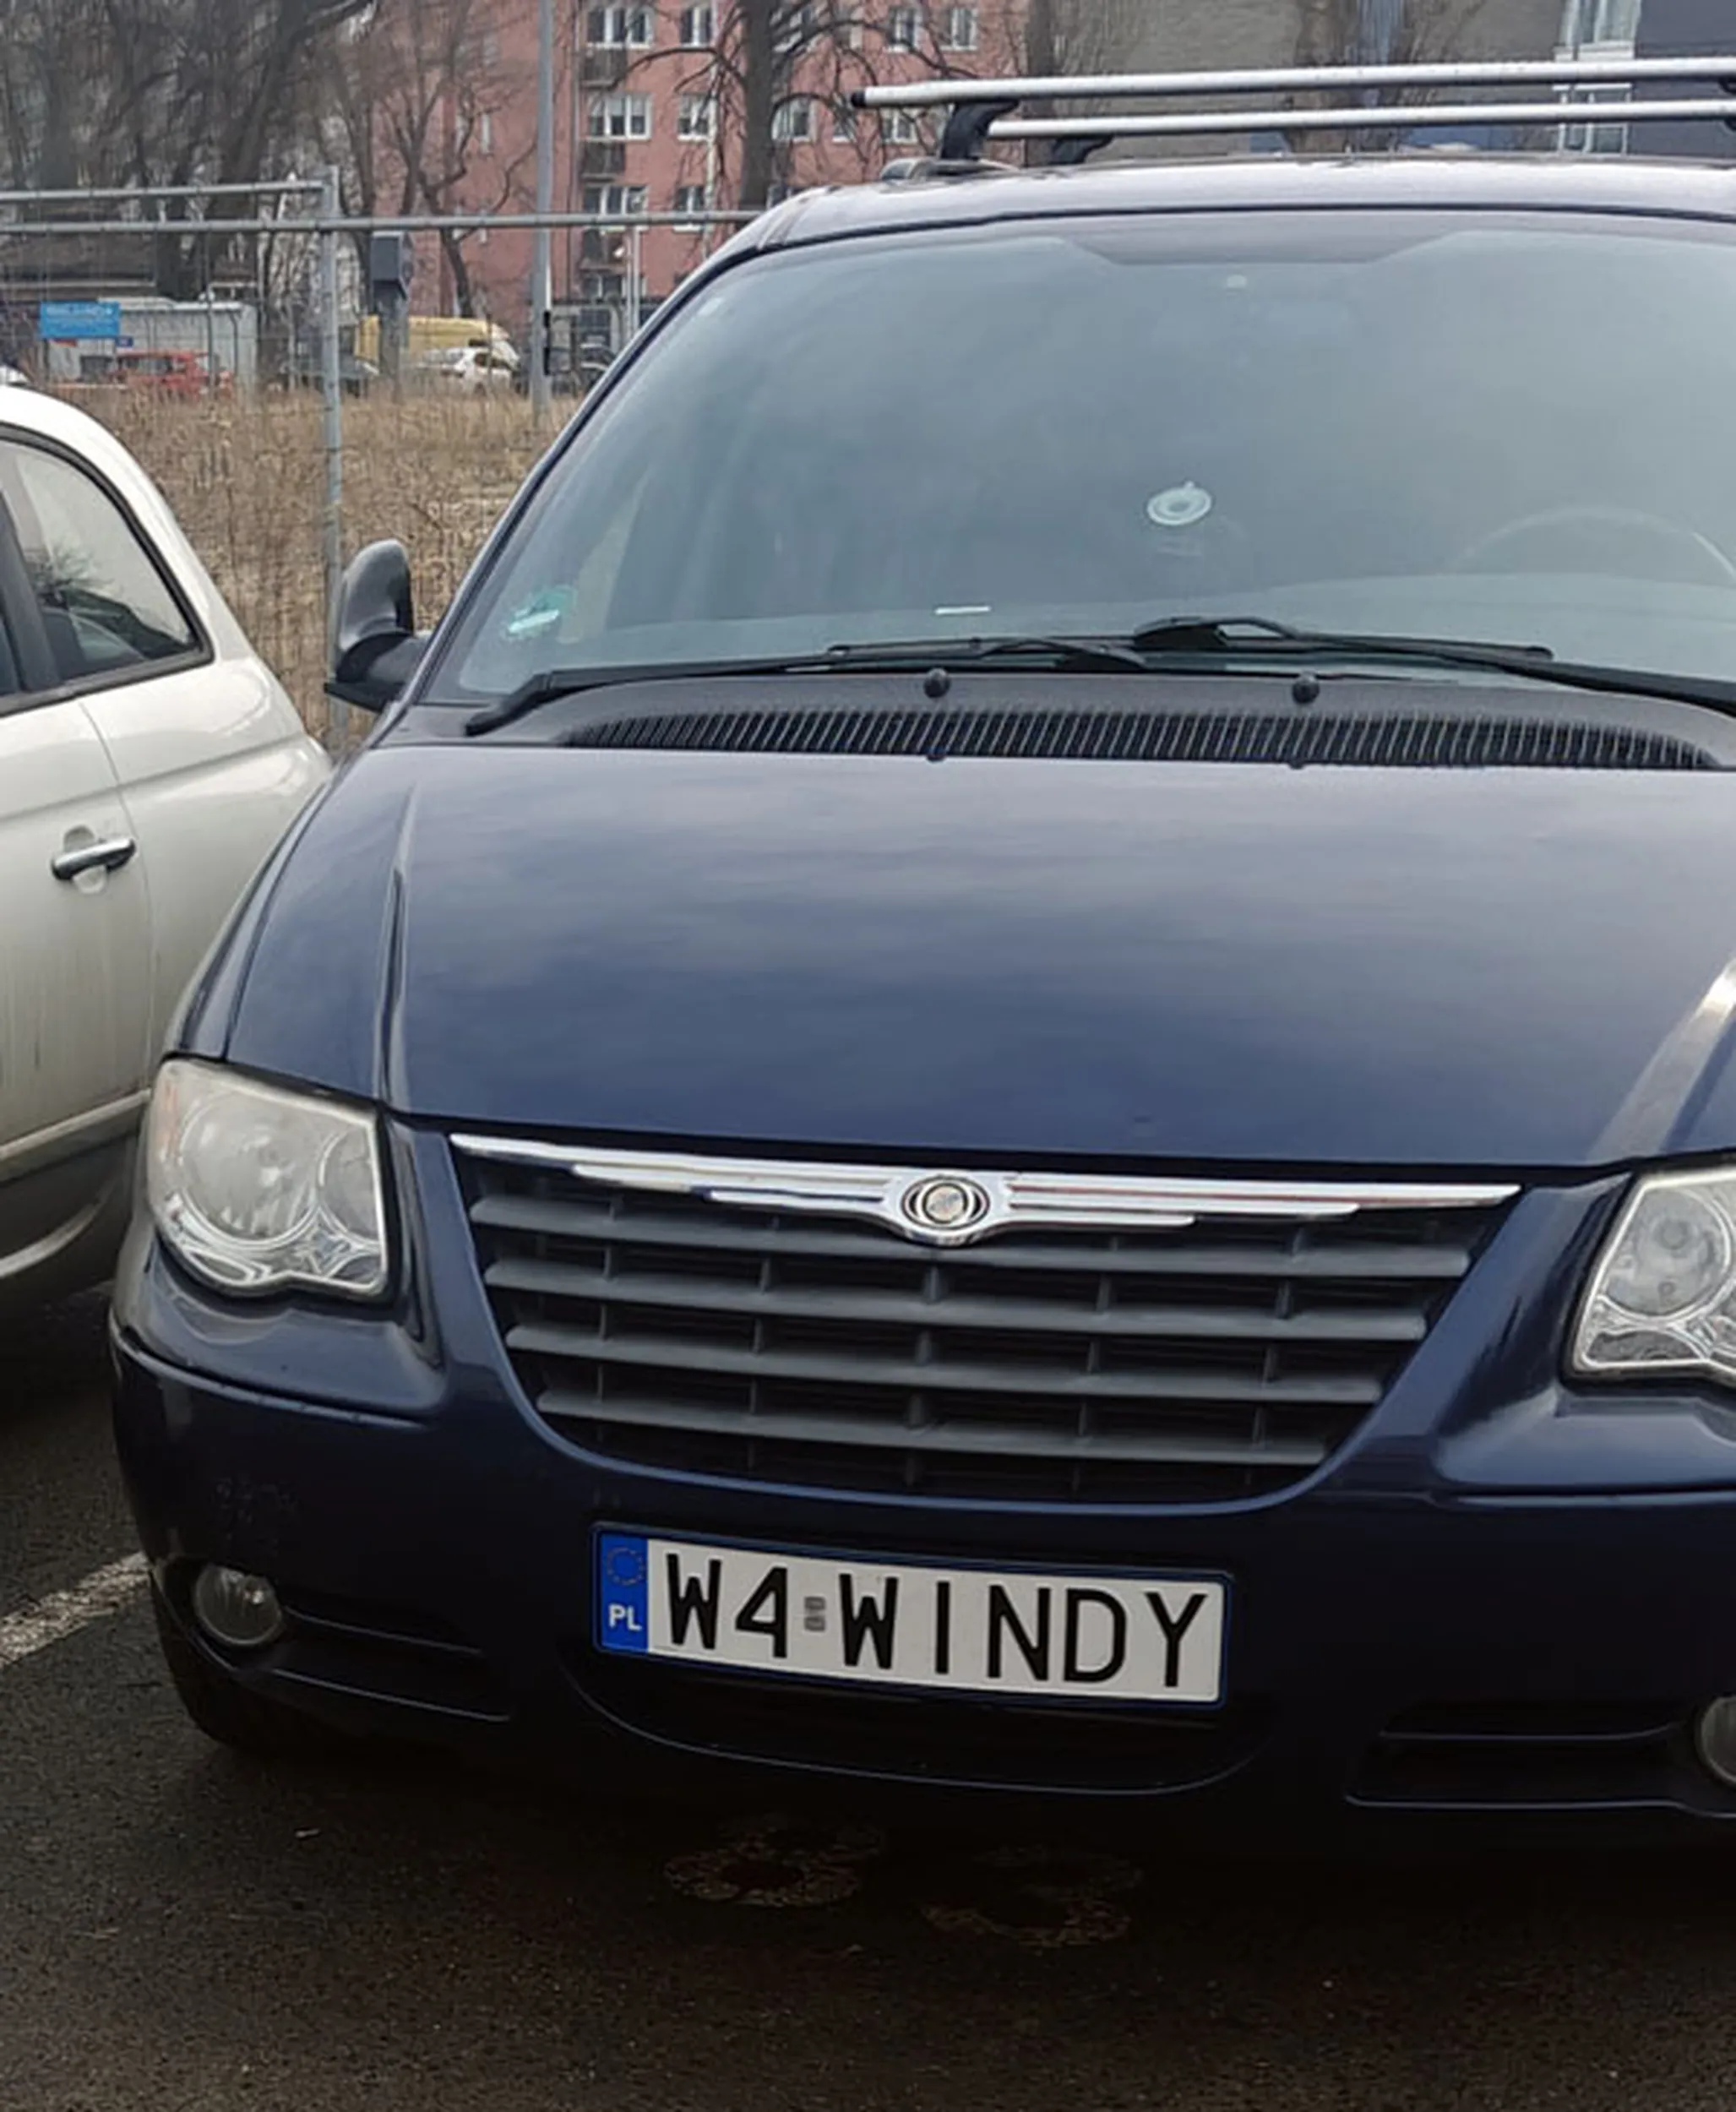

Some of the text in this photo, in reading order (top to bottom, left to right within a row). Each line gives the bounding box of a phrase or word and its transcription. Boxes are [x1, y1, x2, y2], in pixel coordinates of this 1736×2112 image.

[608, 1603, 642, 1631] PL
[667, 1553, 1207, 1688] W4 WINDY
